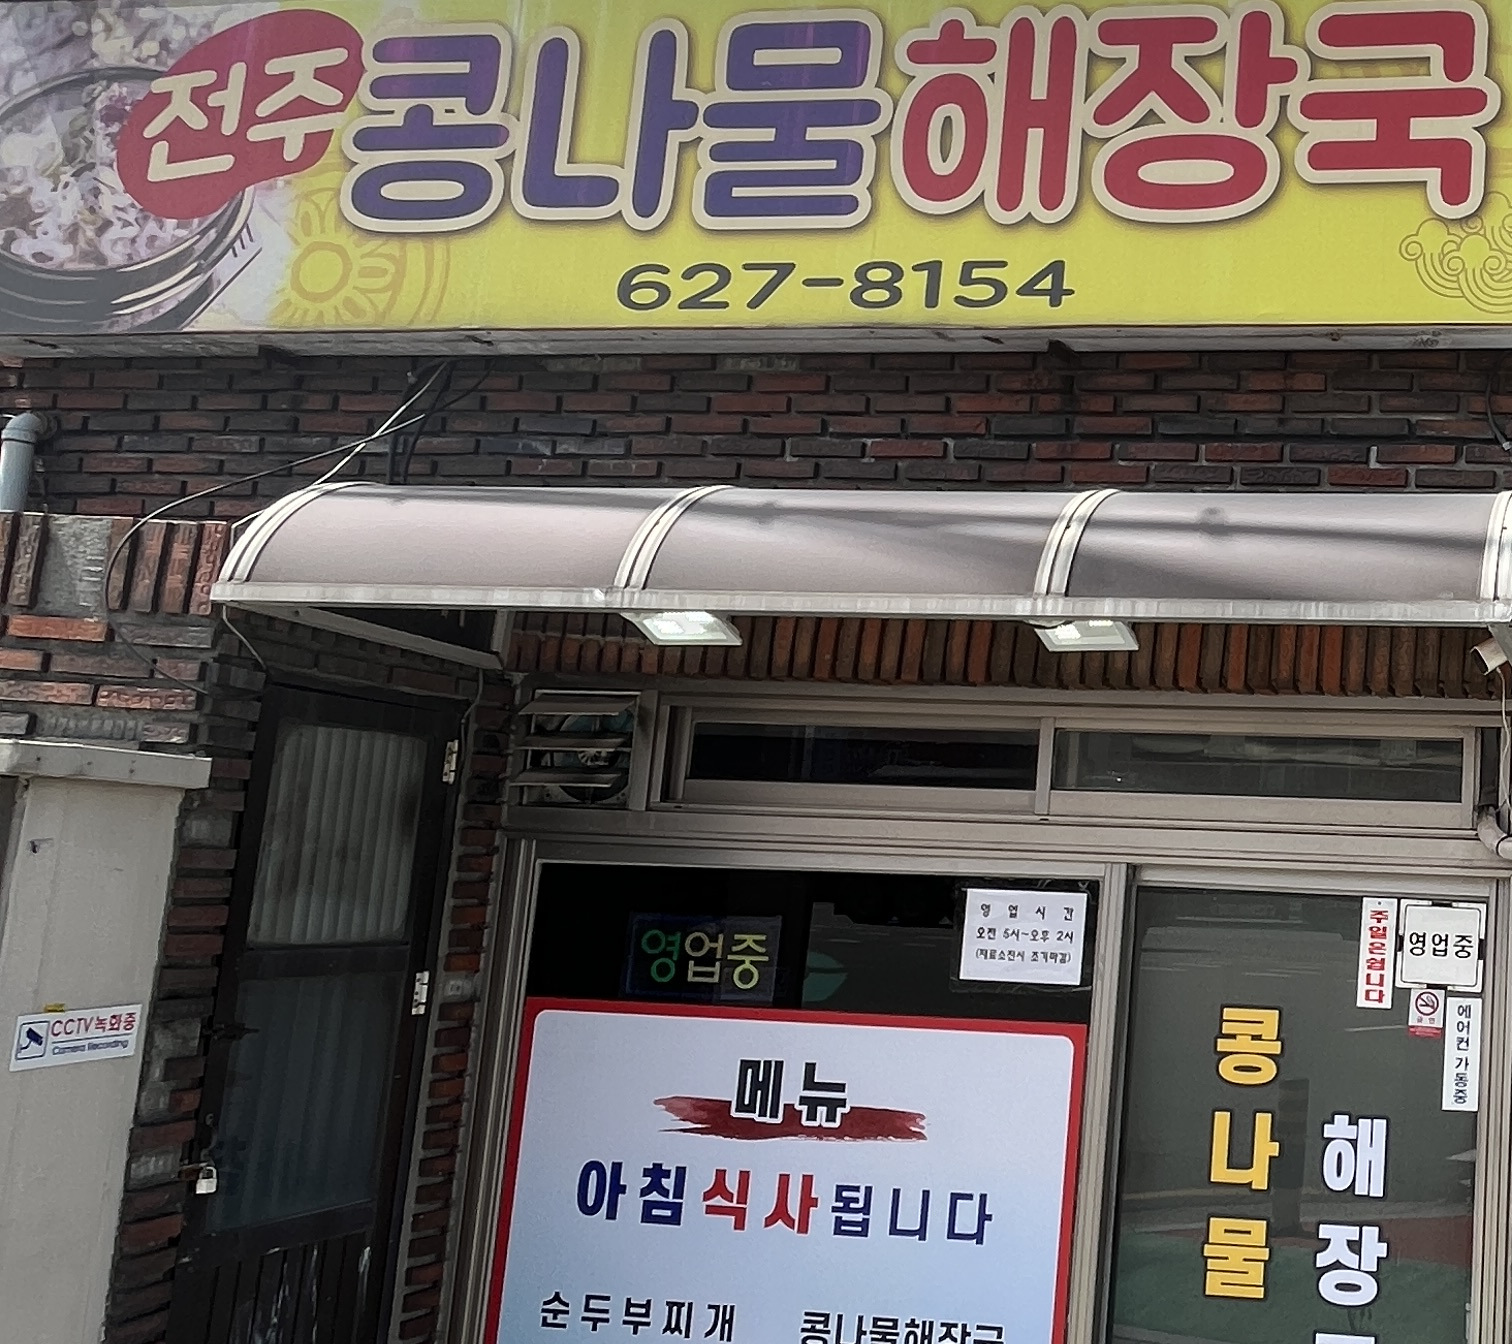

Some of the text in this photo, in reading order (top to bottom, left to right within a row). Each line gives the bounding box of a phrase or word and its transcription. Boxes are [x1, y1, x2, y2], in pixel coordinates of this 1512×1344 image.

[141, 44, 352, 183] 전주
[617, 259, 1075, 311] 627-8154
[640, 929, 770, 990] 영업중
[976, 926, 996, 940] 오전
[1056, 930, 1074, 944] 2시
[1409, 931, 1474, 959] 영업중
[1453, 1004, 1472, 1104] 에어컨 가동중
[732, 1059, 848, 1124] 메뉴
[1203, 1006, 1281, 1300] 콩나물
[540, 1291, 736, 1343] 순두부찌개
